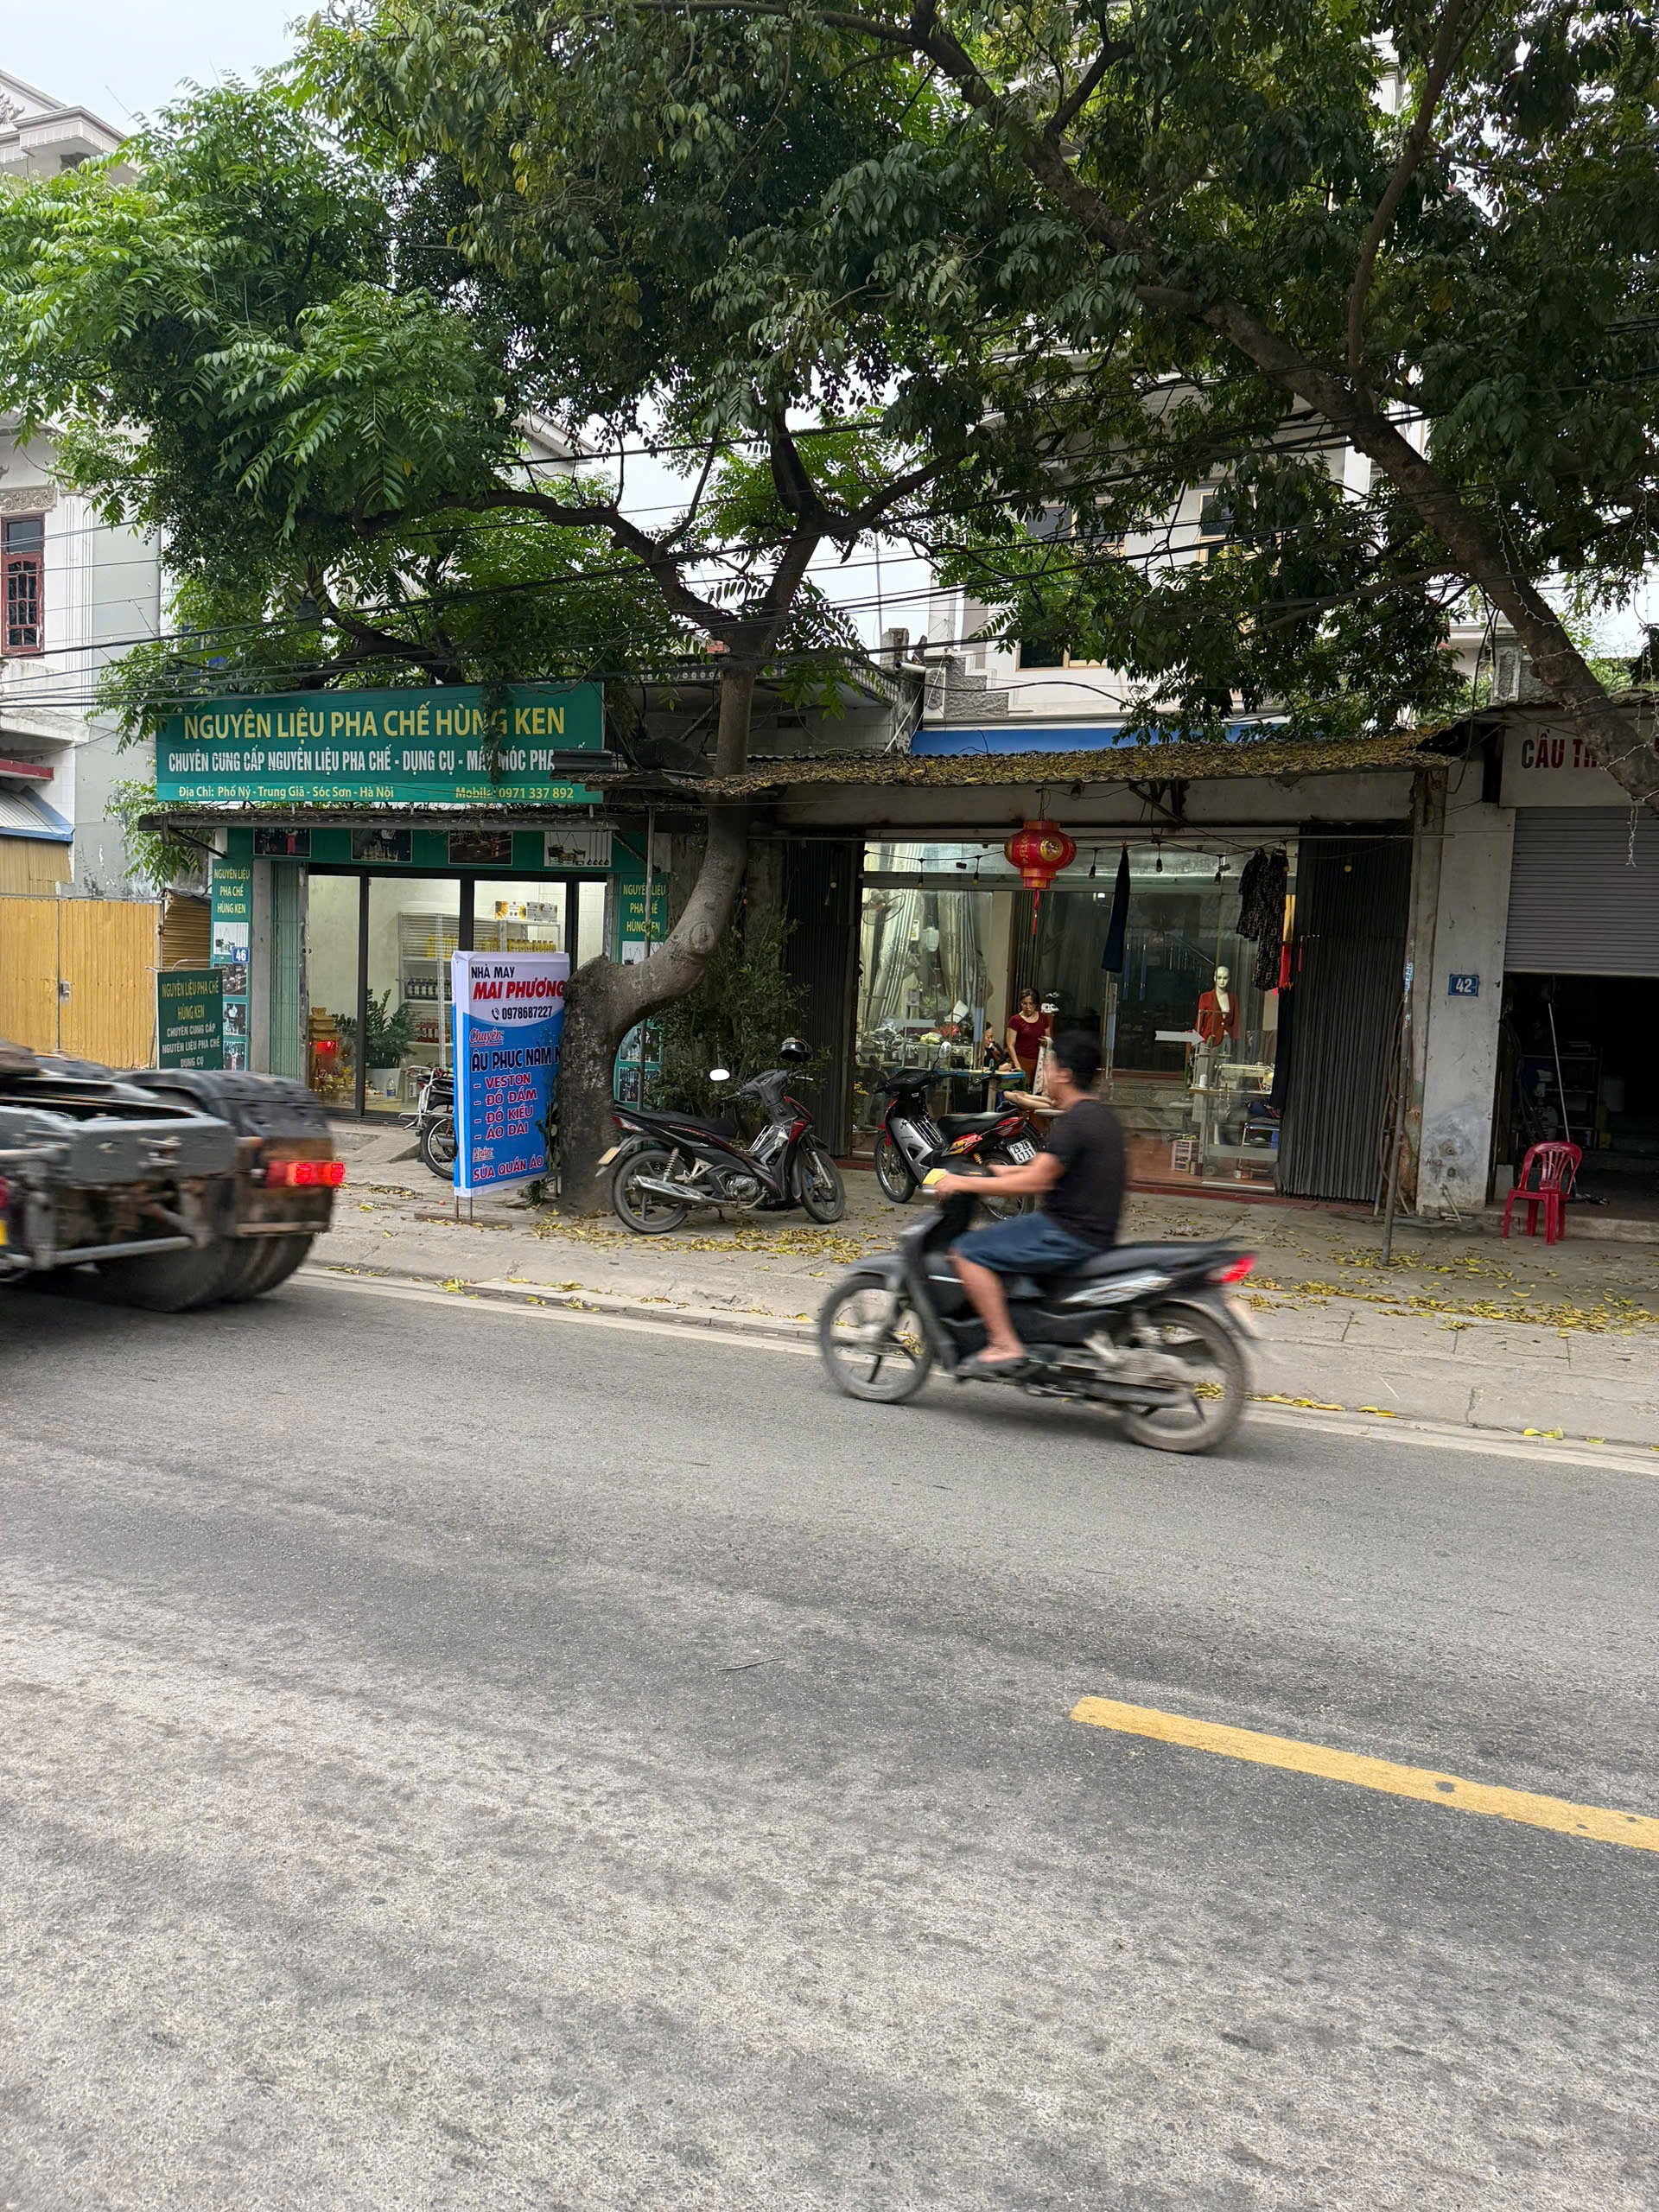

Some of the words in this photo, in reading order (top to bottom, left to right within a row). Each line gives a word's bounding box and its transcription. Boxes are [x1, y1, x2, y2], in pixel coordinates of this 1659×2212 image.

[184, 709, 270, 739] NGUYÊN
[277, 707, 324, 744] LIỆU
[331, 710, 378, 737] PHA
[384, 701, 429, 736] CHẾ
[436, 703, 507, 736] HÙNG
[515, 707, 565, 734] KEN
[1522, 729, 1564, 768] CẦU
[168, 748, 208, 772] CHUYÊN
[212, 752, 240, 772] CUNG
[243, 744, 264, 772] CẤP
[268, 747, 311, 771] NGUYÊN
[315, 747, 339, 775] LIỆU
[342, 751, 365, 771] PHA
[369, 744, 391, 771] CHẾ
[403, 750, 435, 775] DỤNG
[439, 750, 454, 775] CỤ
[498, 746, 525, 771] MÓC
[530, 749, 555, 771] PHA
[179, 786, 194, 798] Địa
[196, 785, 214, 797] Chỉ:
[218, 785, 236, 797] Phố
[258, 786, 286, 798] Trung
[289, 785, 304, 797] Giã
[313, 785, 330, 797] Sóc
[333, 786, 352, 797] Sơn
[359, 785, 373, 797] Hà
[376, 785, 394, 800] Nội
[499, 788, 525, 798] 0971
[529, 788, 550, 798] 337
[553, 787, 574, 798] 892
[213, 868, 237, 879] NGUYÊN
[238, 867, 250, 882] LIỆU
[219, 886, 231, 896] PHA
[232, 881, 244, 896] CHẾ
[623, 882, 646, 895] NGUYÊ
[217, 901, 233, 913] HÙNG
[234, 903, 245, 913] KEN
[629, 902, 644, 913] PHA
[626, 918, 645, 932] HÙNG
[235, 950, 246, 961] 46
[471, 963, 490, 978] NHÀ
[493, 967, 515, 978] MAY
[162, 980, 184, 998] NGUYÊN
[197, 981, 208, 995] PHA
[209, 976, 219, 993] CHẾ
[473, 982, 503, 1000] MAI
[505, 977, 565, 999] PHƯƠNG
[1456, 978, 1471, 993] 42
[177, 1003, 193, 1020] HÙNG
[194, 1004, 205, 1020] KEN
[502, 1006, 552, 1020] 0978687227
[167, 1022, 188, 1037] CHUYÊN
[189, 1025, 204, 1036] CUNG
[205, 1020, 216, 1033] CẤP
[162, 1039, 184, 1054] NGUYÊN
[185, 1039, 197, 1052] LIỆU
[198, 1039, 208, 1051] PHA
[471, 1048, 488, 1072] ÂU
[492, 1048, 523, 1073] PHỤC
[524, 1046, 551, 1067] NAM
[485, 1072, 531, 1089] VESTON
[530, 1154, 544, 1170] ÁO
